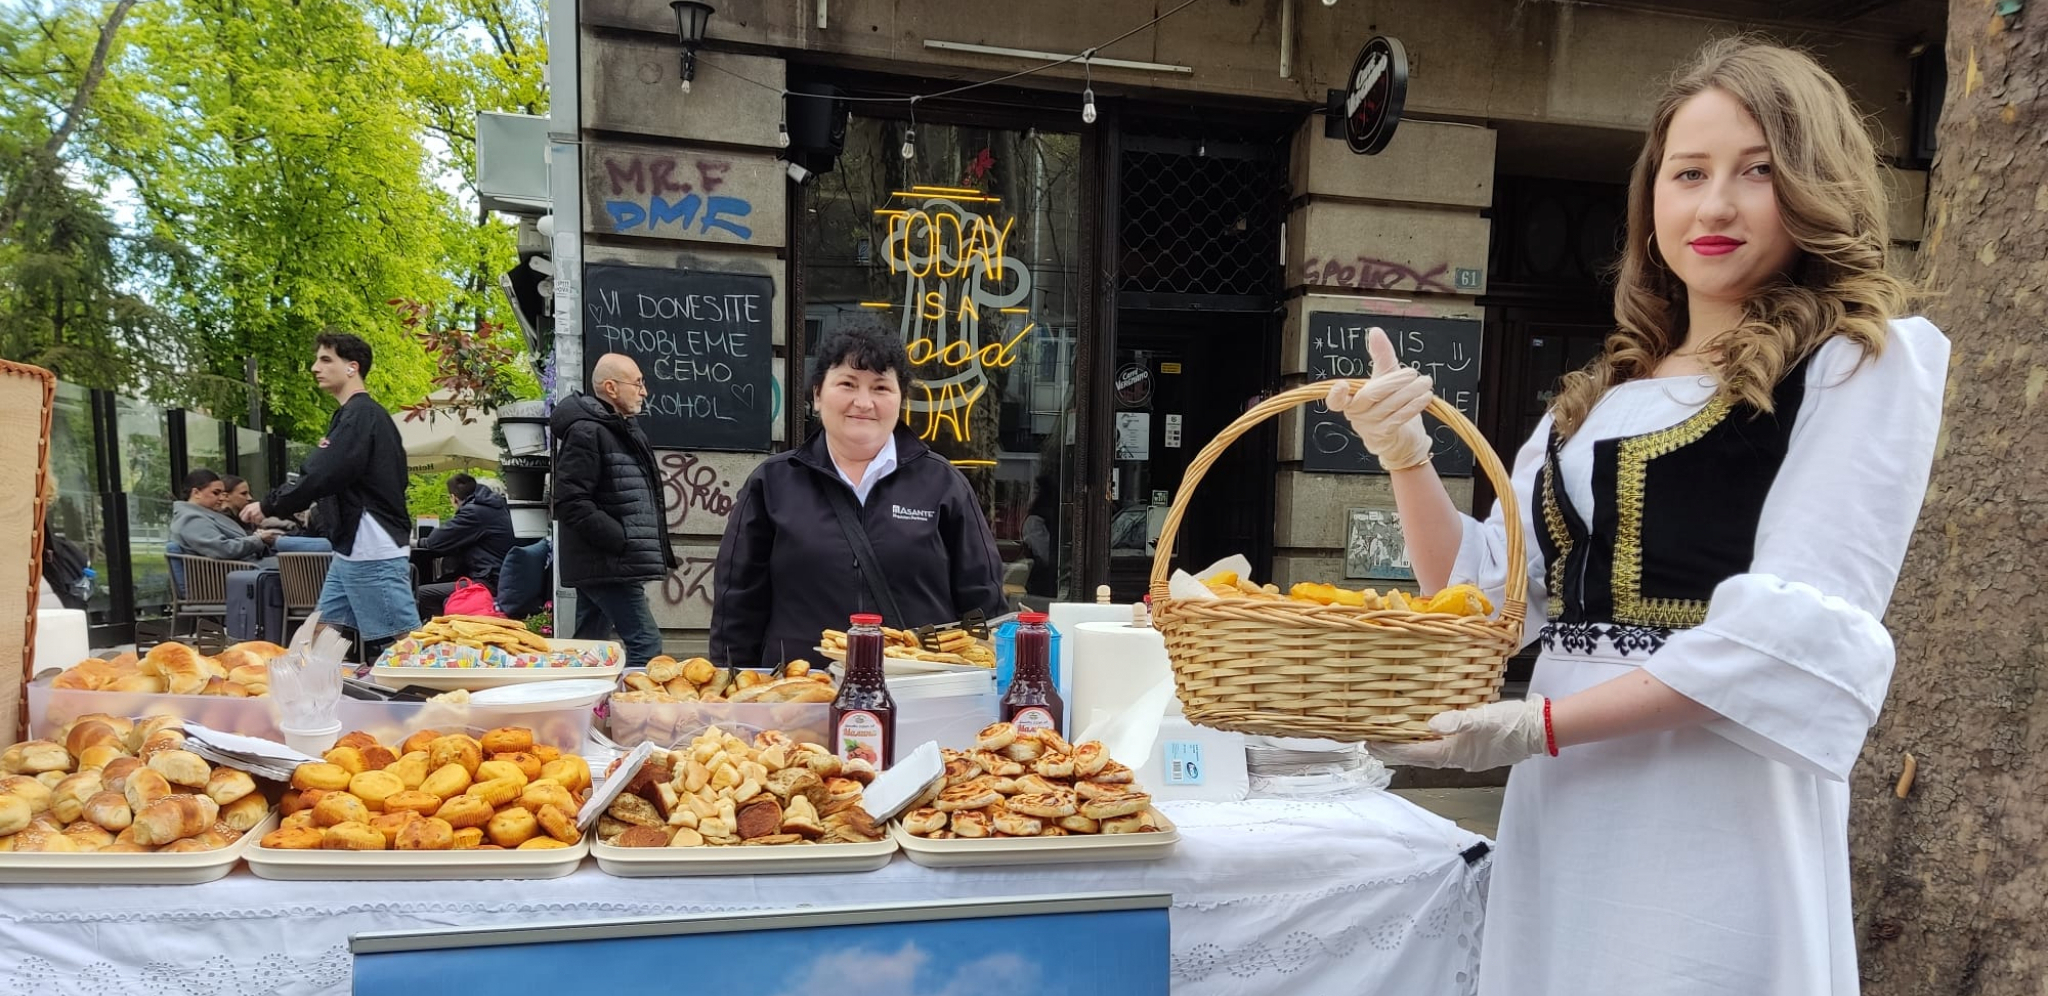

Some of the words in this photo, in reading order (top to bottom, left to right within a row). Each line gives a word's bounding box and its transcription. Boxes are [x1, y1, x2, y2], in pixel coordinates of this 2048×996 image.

[875, 210, 1014, 281] TODAY
[1461, 270, 1477, 286] 61
[599, 288, 621, 316] VI
[637, 293, 761, 323] DONESITE
[916, 292, 946, 320] IS
[957, 295, 979, 321] A
[596, 324, 749, 358] PROBLEME
[907, 323, 1035, 368] ood
[1400, 330, 1425, 357] IS
[906, 380, 985, 442] DAY
[900, 506, 935, 518] ASANTE
